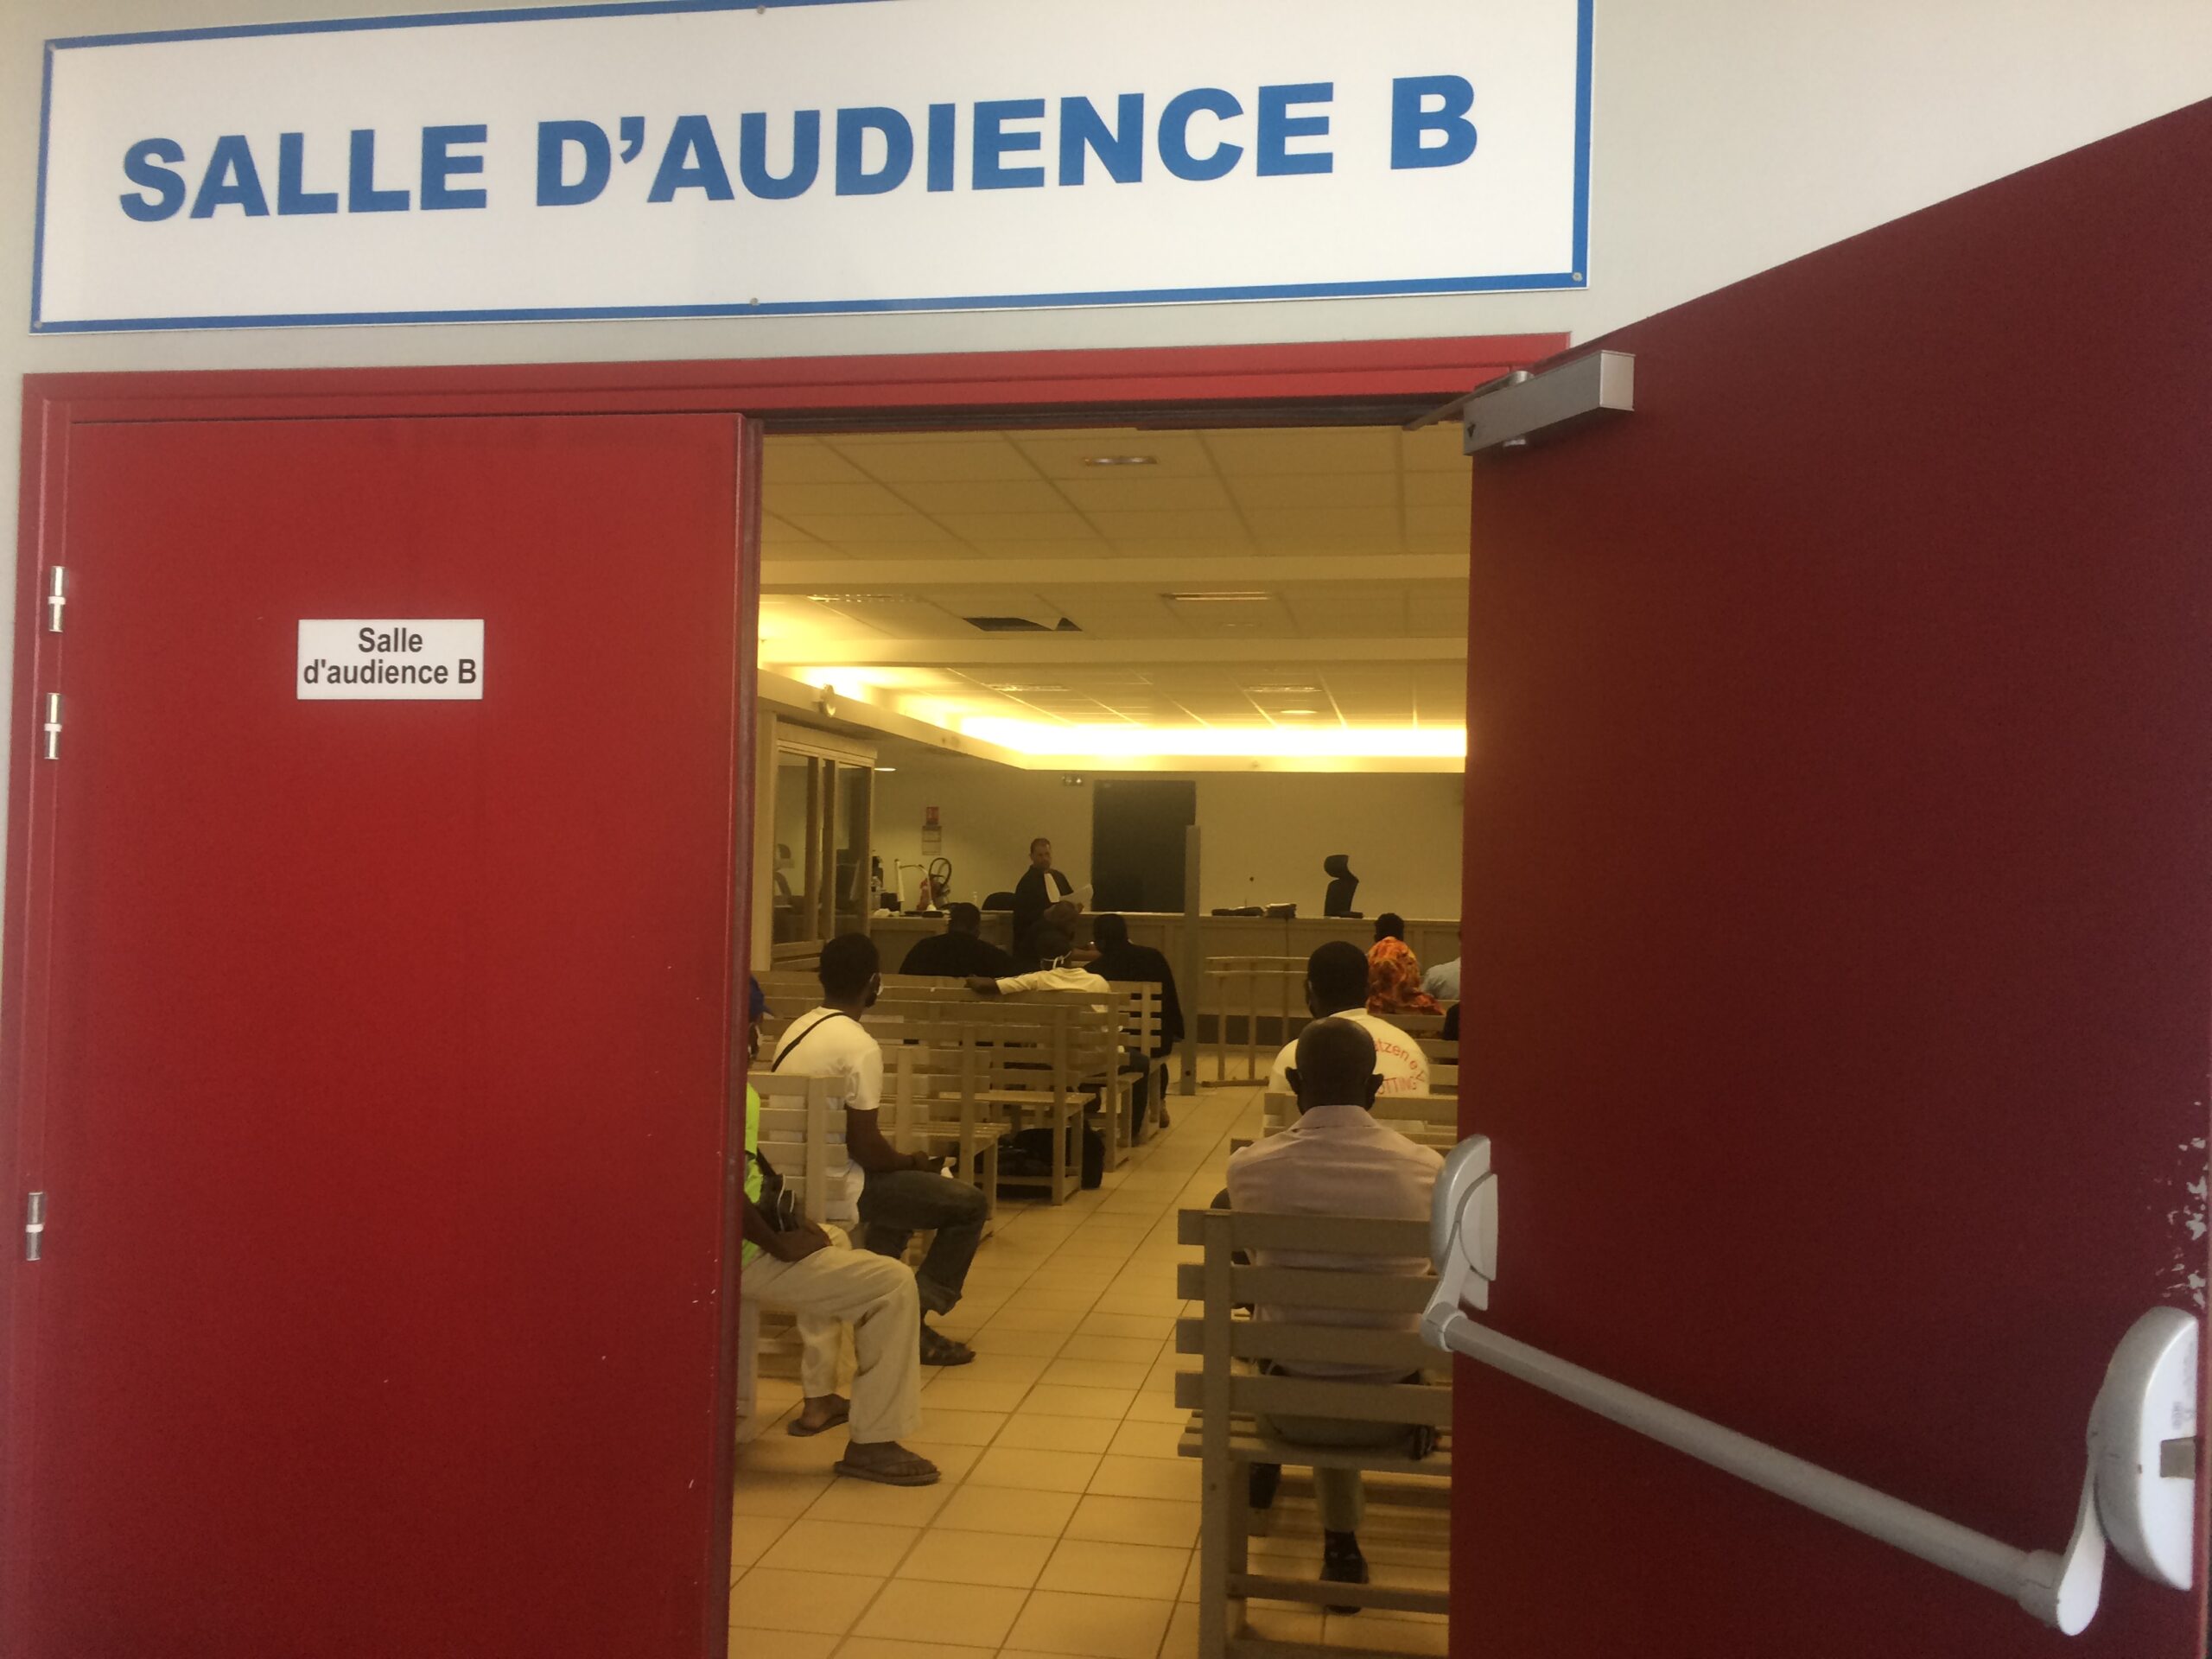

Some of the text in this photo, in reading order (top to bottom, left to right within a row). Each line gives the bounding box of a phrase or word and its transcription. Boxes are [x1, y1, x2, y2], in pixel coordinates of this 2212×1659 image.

[119, 124, 487, 222] SALLE
[1391, 75, 1477, 169] B
[358, 627, 423, 652] Salle
[303, 658, 477, 684] d'audience B
